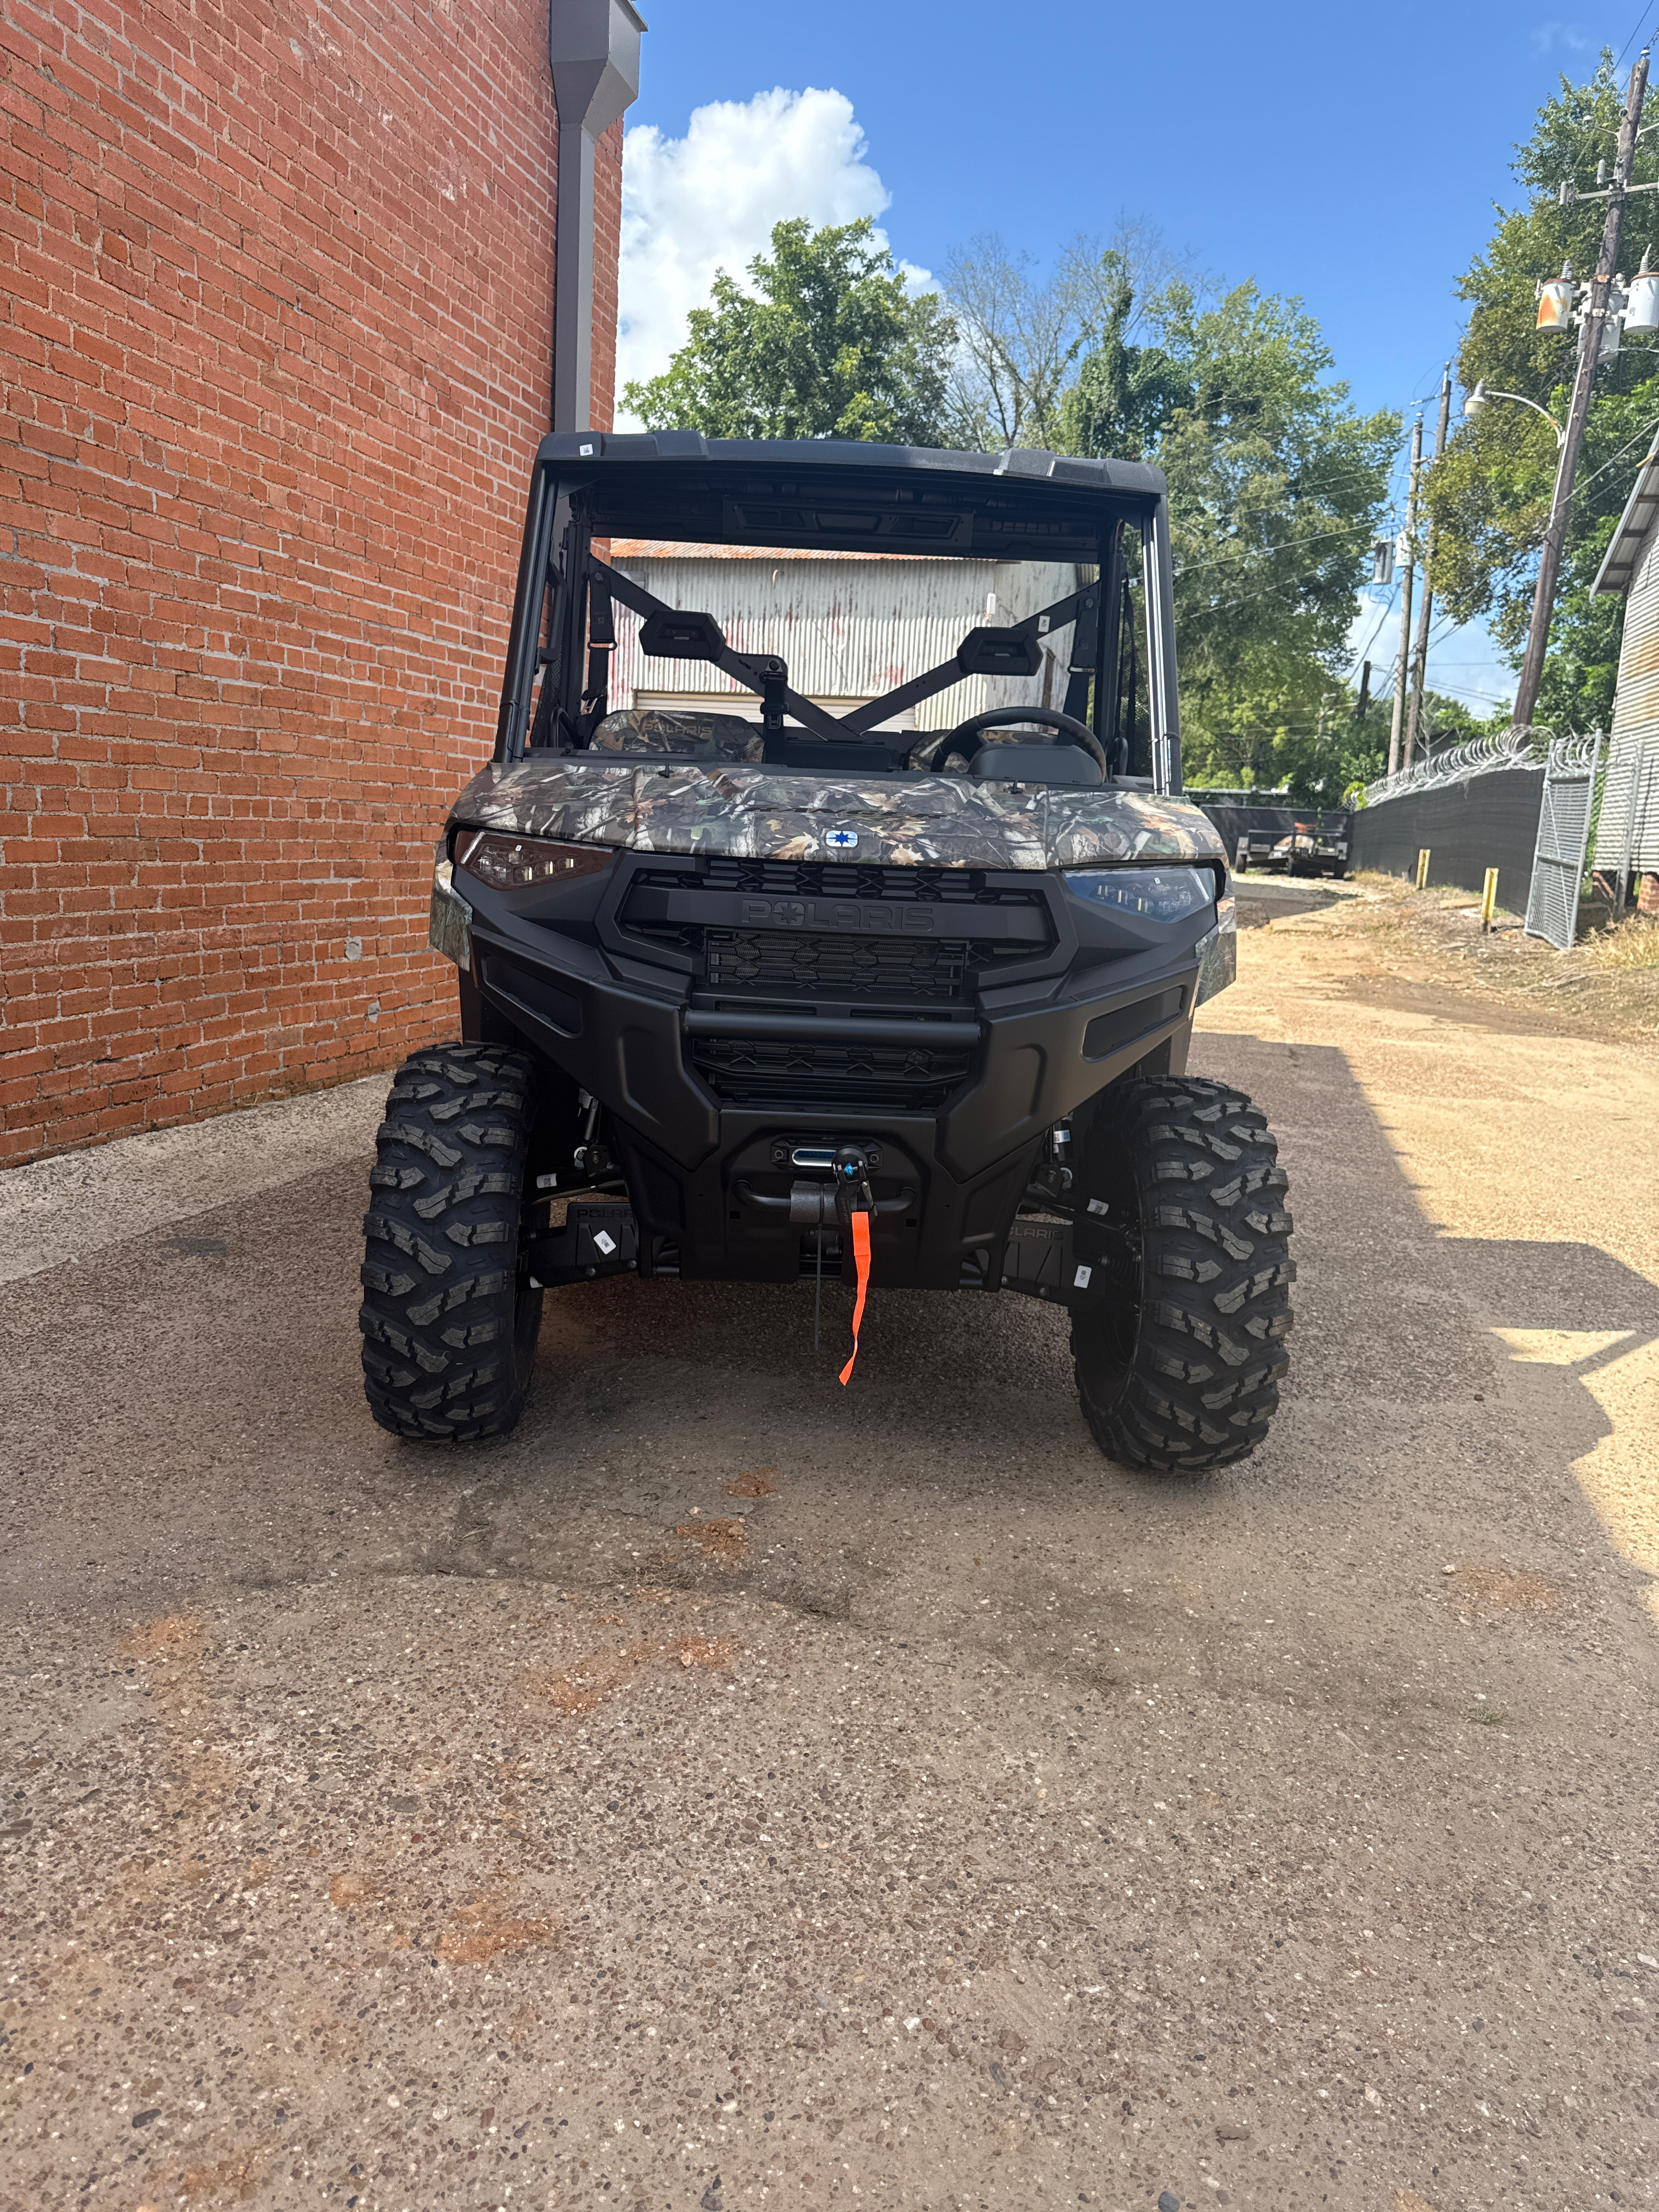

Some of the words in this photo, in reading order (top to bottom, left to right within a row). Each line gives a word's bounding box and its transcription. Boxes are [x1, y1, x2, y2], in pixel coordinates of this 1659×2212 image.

[642, 723, 712, 735] POLARIS
[741, 806, 948, 820] RANGER
[742, 898, 934, 932] POLARIS
[577, 1209, 633, 1218] POLAR
[1009, 1226, 1064, 1240] LARIS
